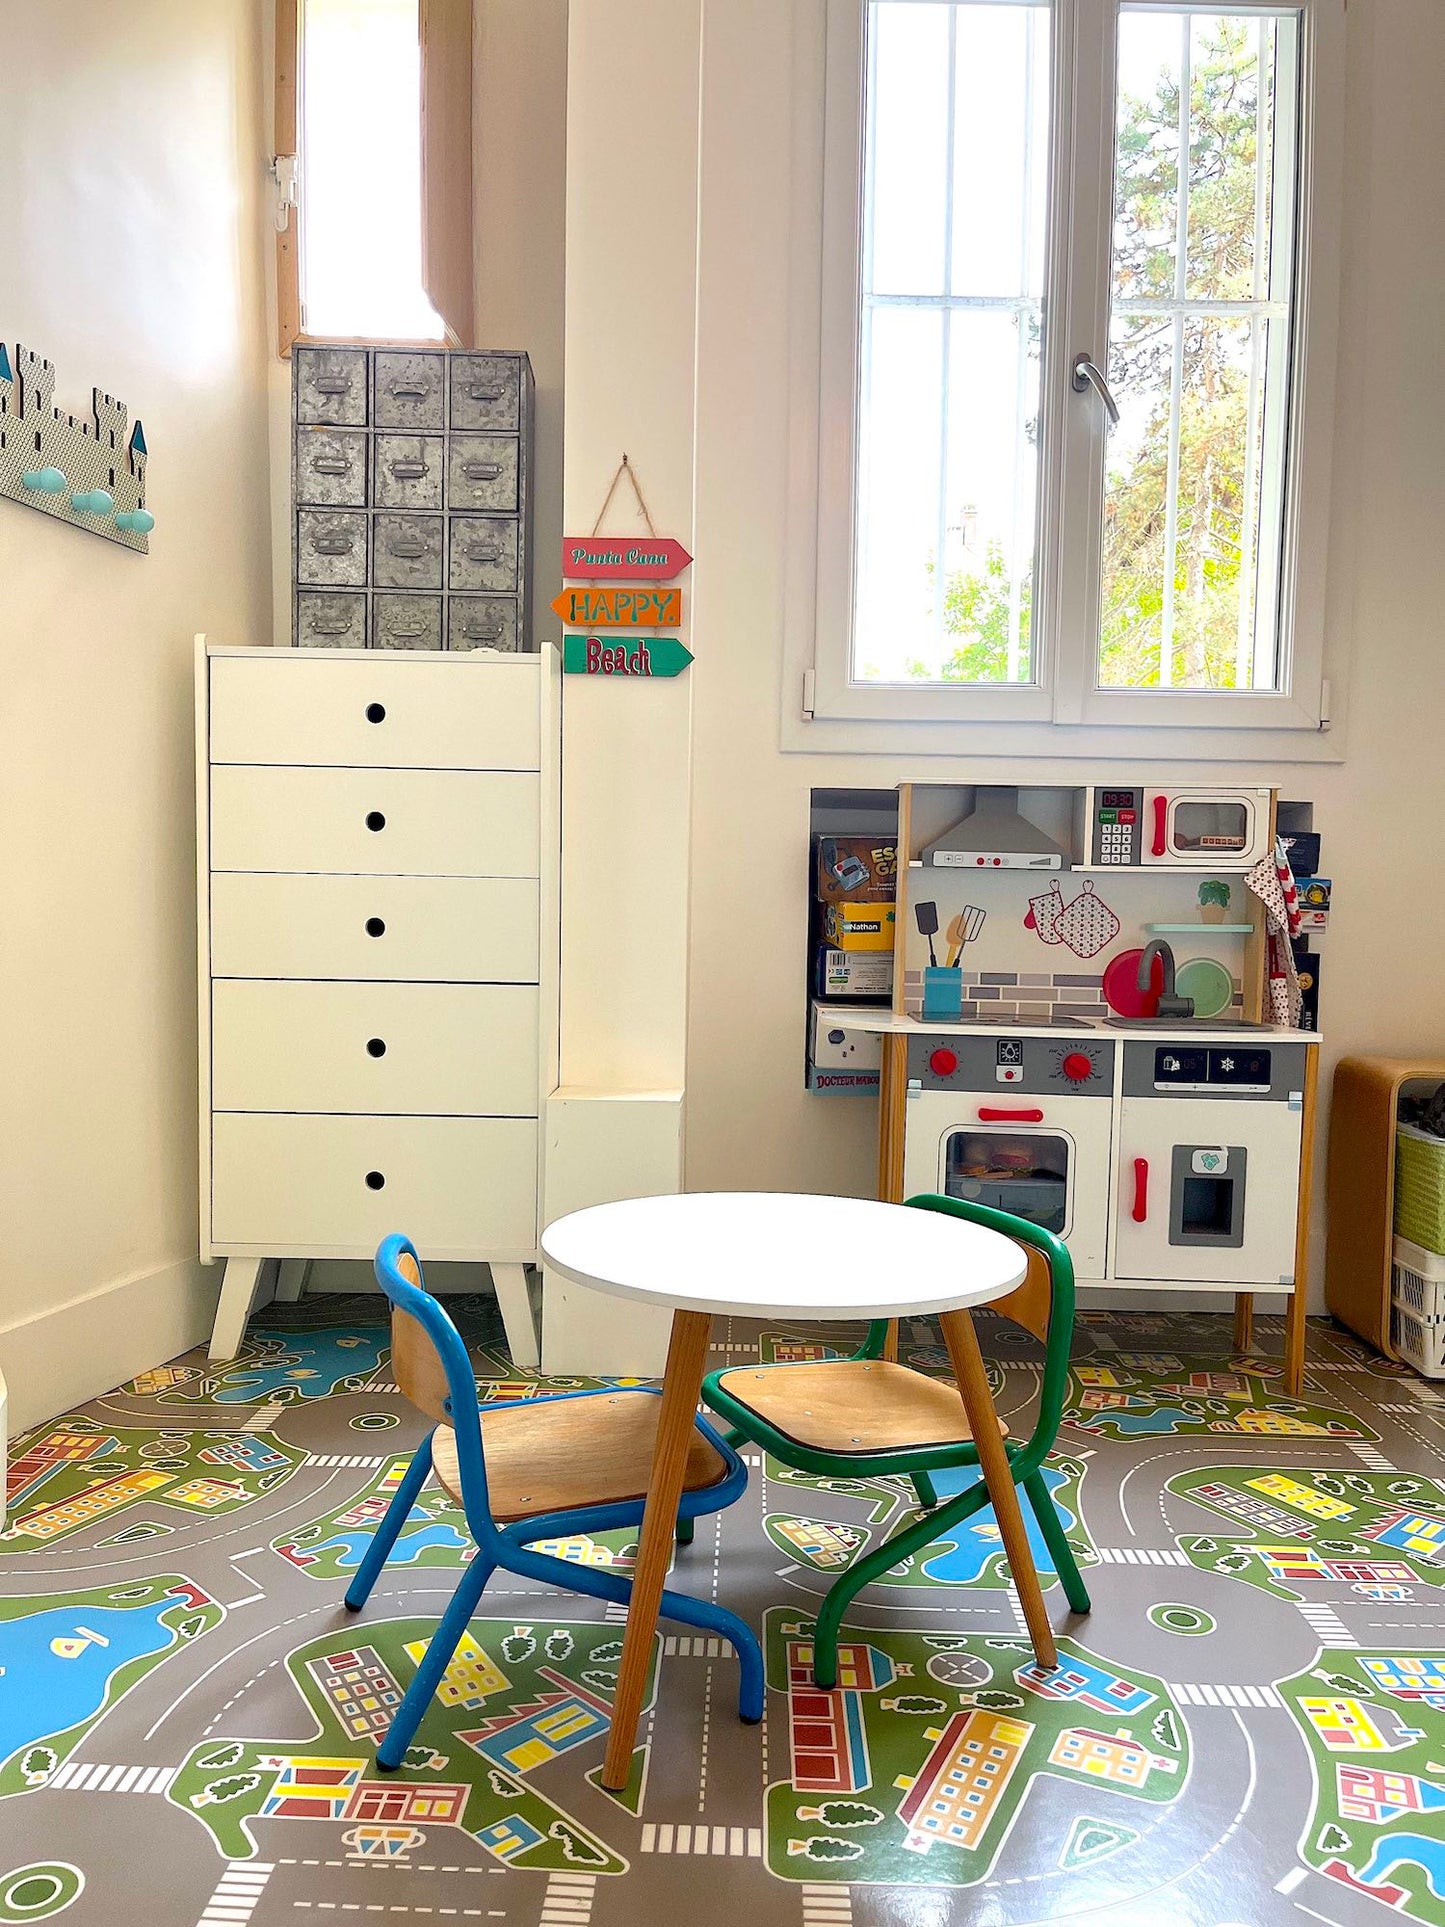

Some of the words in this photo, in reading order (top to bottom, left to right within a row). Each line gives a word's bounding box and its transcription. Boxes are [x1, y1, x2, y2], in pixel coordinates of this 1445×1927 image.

[570, 547, 622, 565] Punta
[626, 547, 668, 565] Cana
[586, 637, 653, 676] Beach
[850, 923, 878, 931] Nathan
[816, 1075, 855, 1089] DOCTEUR
